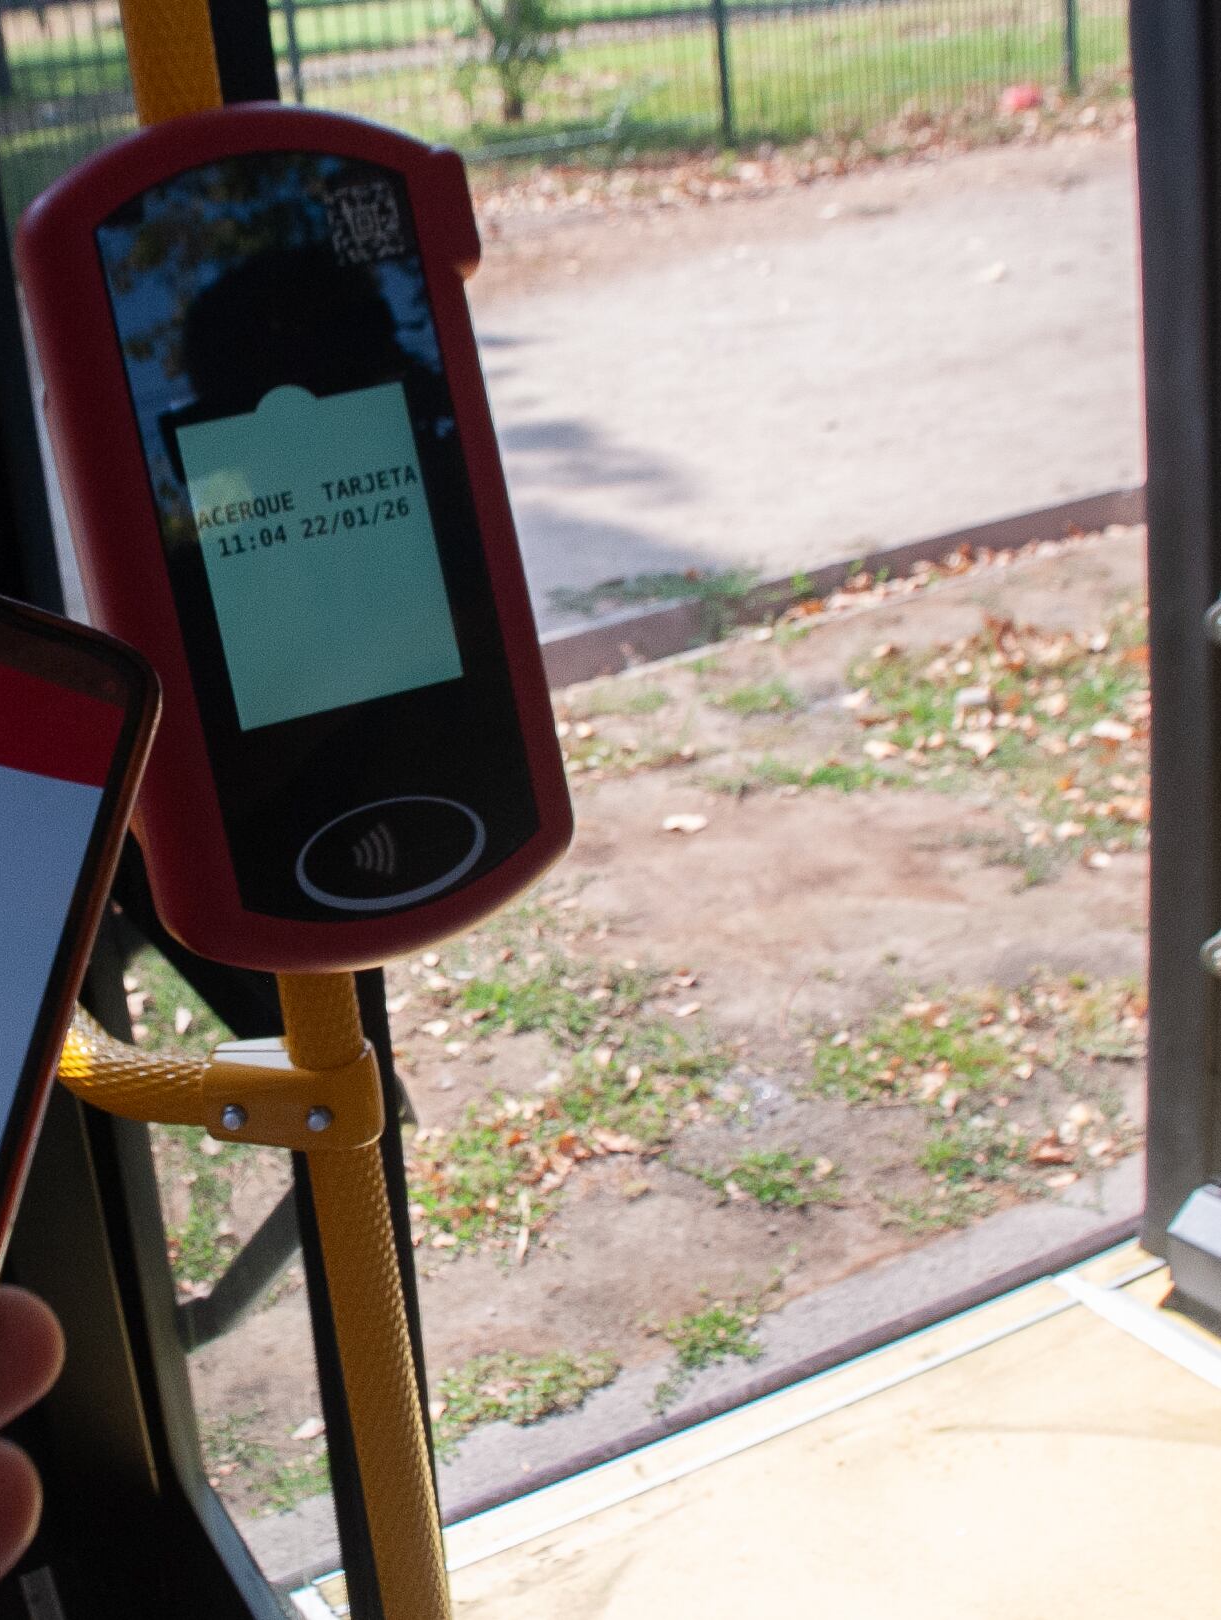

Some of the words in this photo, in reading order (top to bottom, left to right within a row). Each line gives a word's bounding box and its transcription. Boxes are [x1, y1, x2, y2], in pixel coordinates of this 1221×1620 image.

[198, 490, 294, 529] ACERQUE
[322, 465, 418, 502] TARJETA
[218, 524, 287, 557] 11:04
[301, 497, 411, 539] 22/01/26
